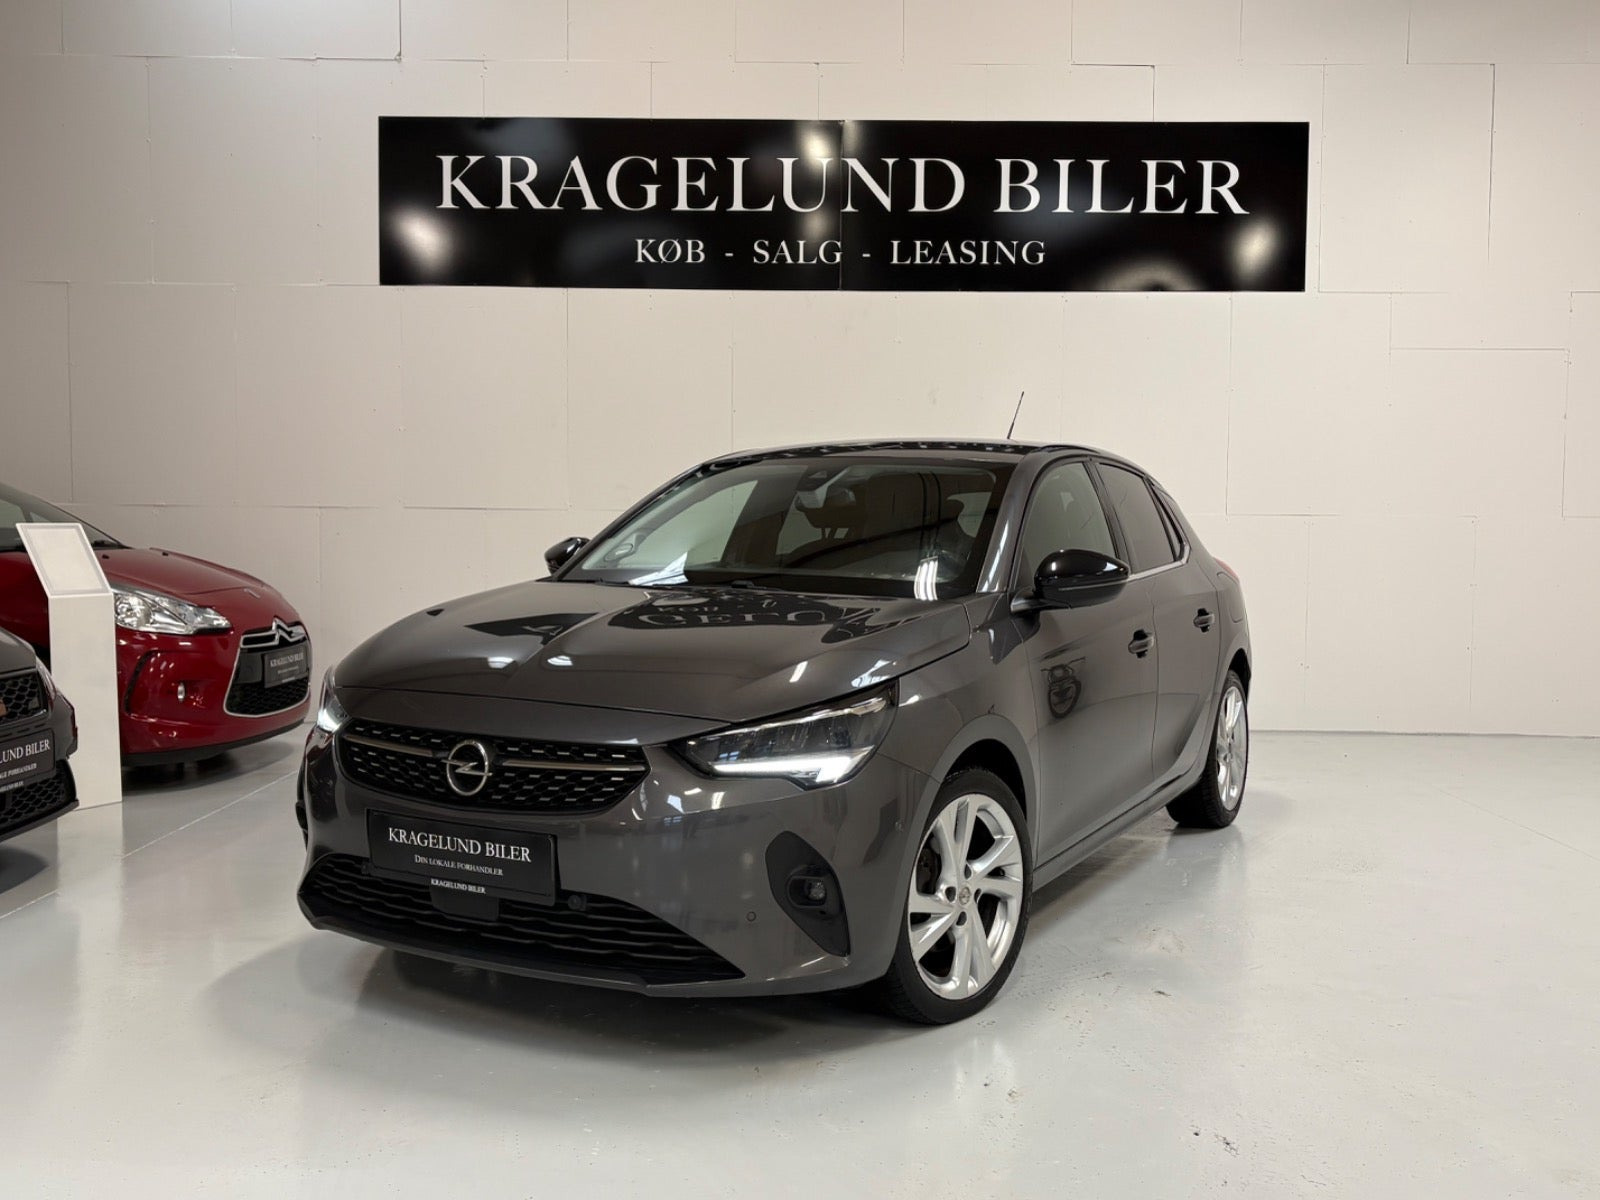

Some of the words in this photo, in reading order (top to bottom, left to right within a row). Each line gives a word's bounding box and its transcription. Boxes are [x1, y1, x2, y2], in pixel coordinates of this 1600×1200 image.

[436, 155, 965, 214] KRAGELUND
[994, 158, 1250, 215] BILER
[635, 238, 706, 265] KØB
[753, 239, 843, 265] SALG
[890, 240, 1046, 266] LEASING
[25, 739, 50, 757] BILER
[388, 827, 481, 855] KRAGELUND
[485, 841, 532, 863] BILER
